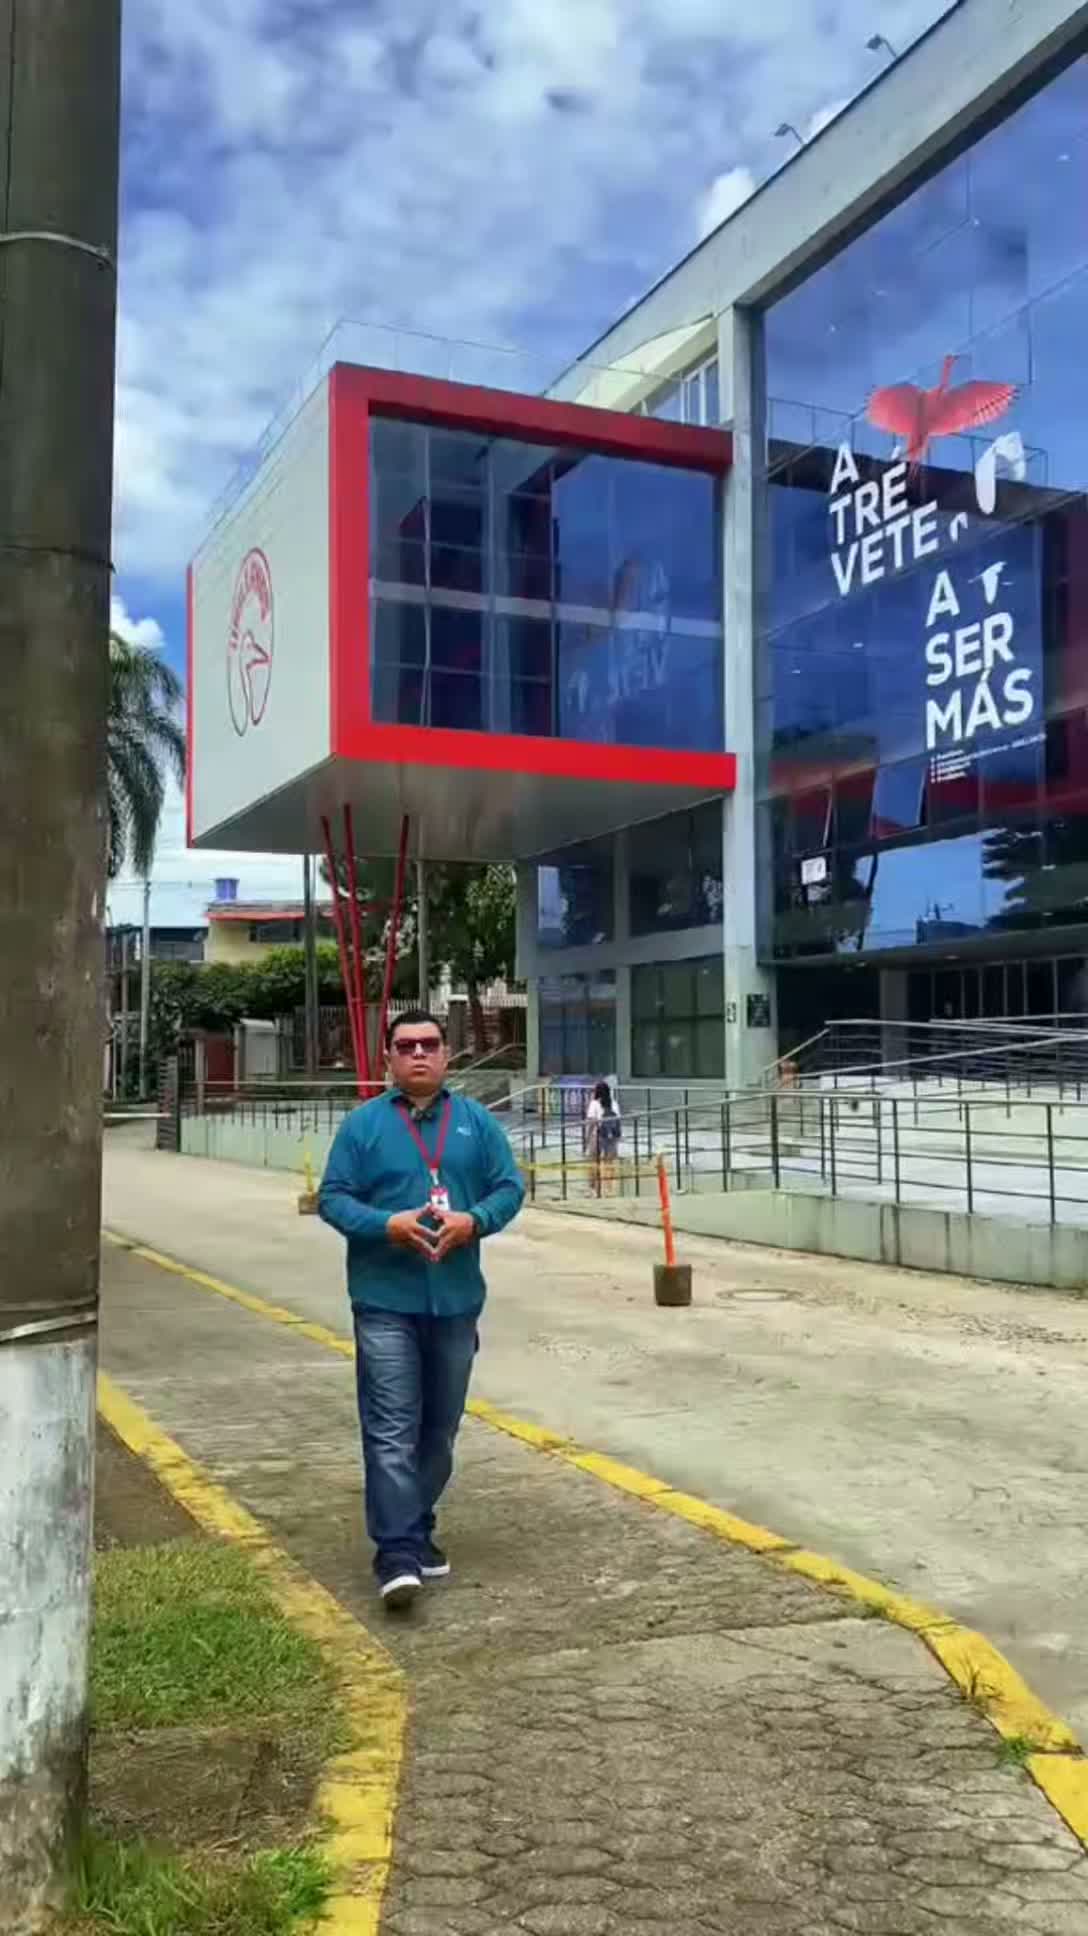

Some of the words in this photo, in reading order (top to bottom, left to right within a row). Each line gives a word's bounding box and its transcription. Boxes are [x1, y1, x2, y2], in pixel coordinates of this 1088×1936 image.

[830, 443, 860, 495] A
[830, 447, 908, 545] TRÉ
[831, 500, 939, 596] VETE
[925, 570, 960, 627] A
[925, 612, 1014, 686] SER
[925, 668, 1034, 750] MÁS
